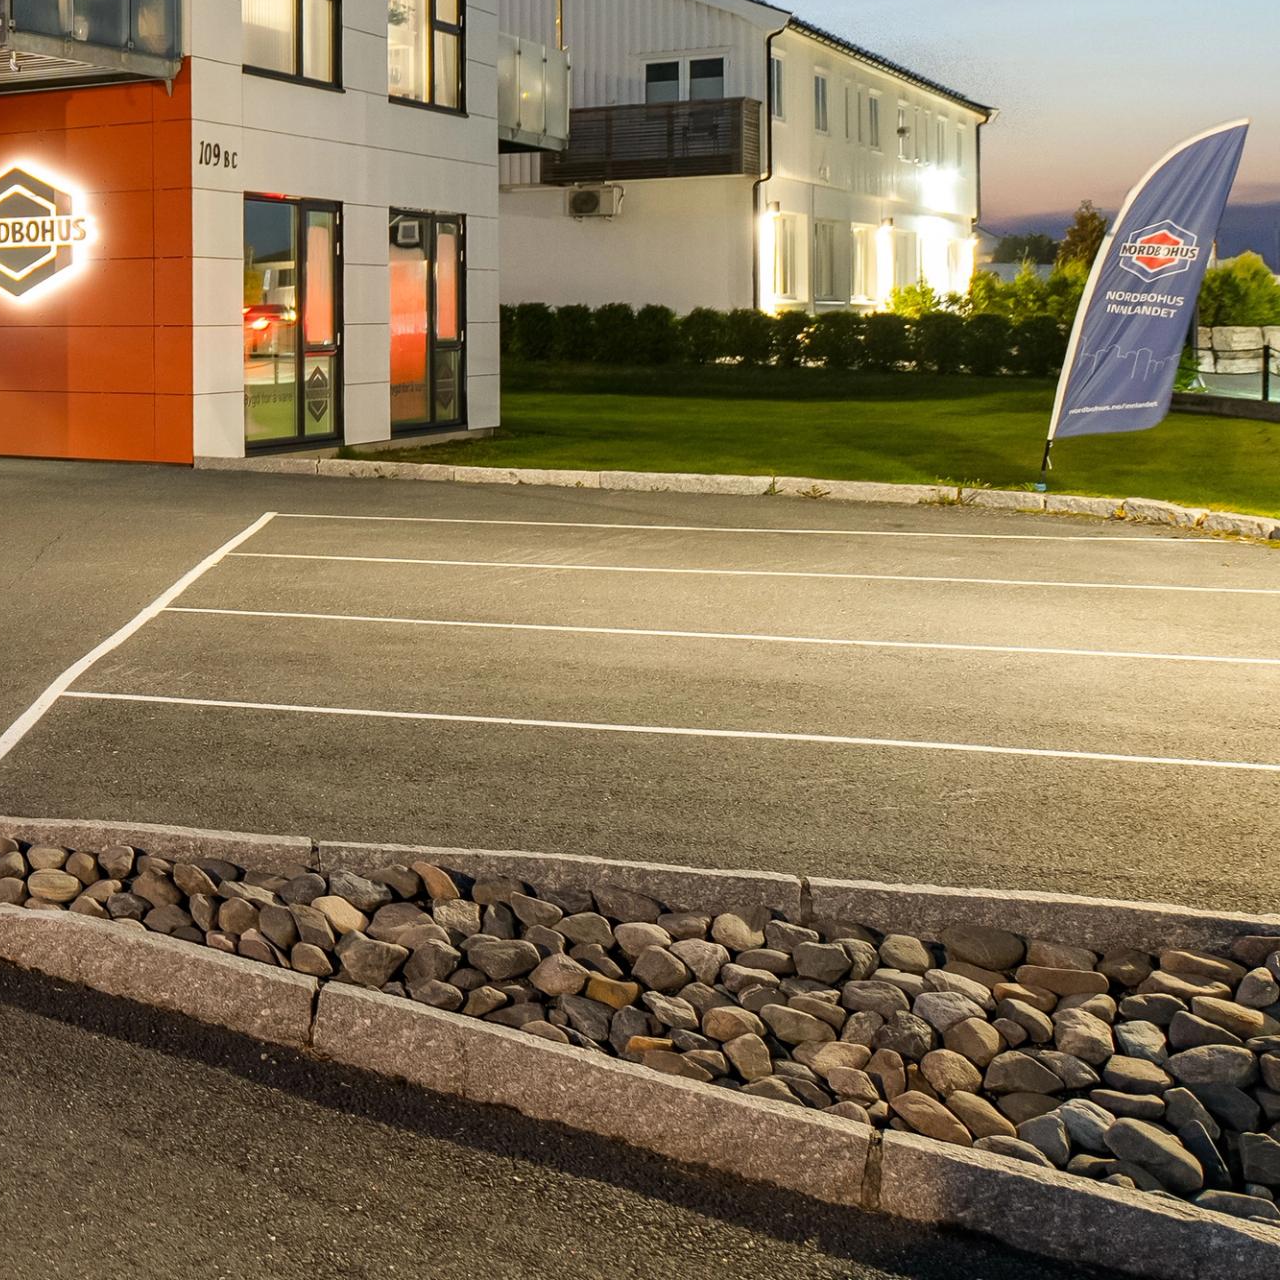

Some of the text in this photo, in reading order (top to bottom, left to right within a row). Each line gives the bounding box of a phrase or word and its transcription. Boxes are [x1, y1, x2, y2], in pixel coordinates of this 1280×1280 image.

[199, 140, 221, 167] 109
[1106, 291, 1185, 306] NORDBOHUS
[1106, 304, 1177, 319] INNLANDET
